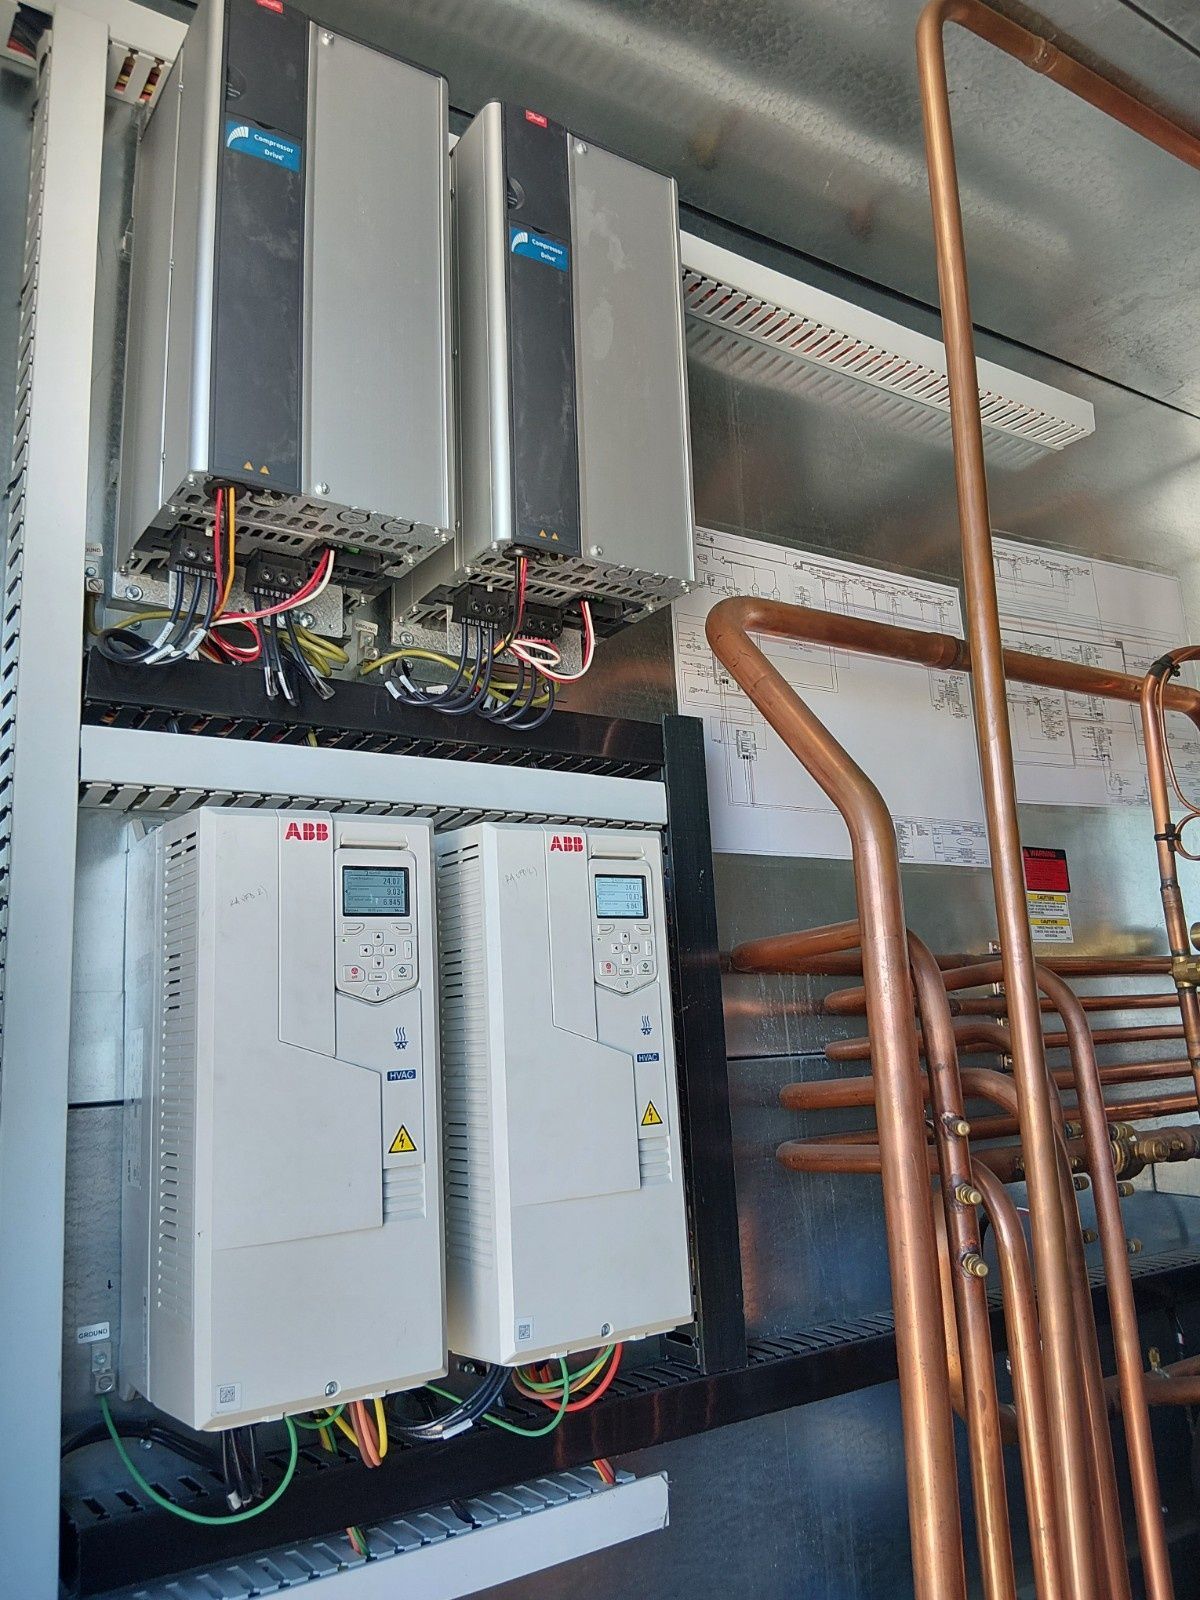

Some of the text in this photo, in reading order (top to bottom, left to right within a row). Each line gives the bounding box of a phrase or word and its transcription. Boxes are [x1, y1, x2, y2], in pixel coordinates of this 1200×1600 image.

[254, 134, 294, 154] Compressor
[531, 238, 563, 255] Compressor
[285, 822, 329, 841] ABB
[550, 836, 584, 852] ABB
[383, 877, 400, 885] 24.07
[386, 888, 401, 896] 9.03
[638, 1053, 658, 1062] HVAC
[390, 1071, 414, 1080] HVAC
[78, 1328, 108, 1340] GROUND
